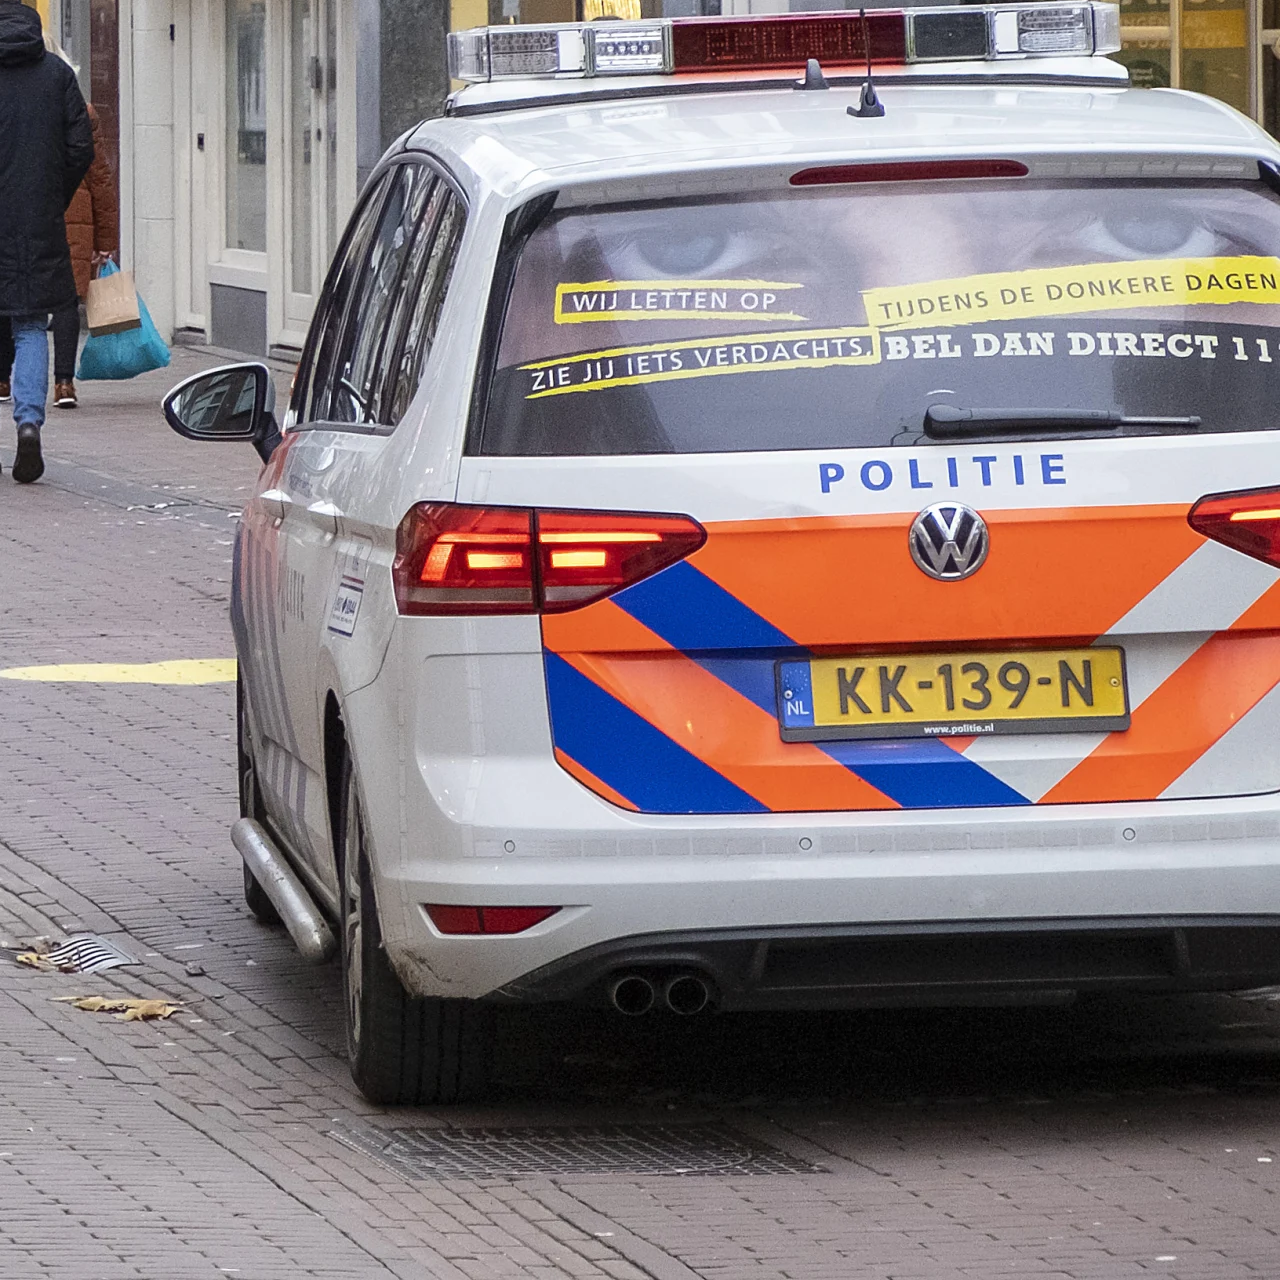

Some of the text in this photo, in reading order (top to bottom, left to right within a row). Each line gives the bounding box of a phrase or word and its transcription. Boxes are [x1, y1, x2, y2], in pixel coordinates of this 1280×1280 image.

[572, 291, 777, 312] WIJ LETTEN OP
[878, 272, 1278, 320] TIJDENS DE DONKERE DAGEN
[884, 331, 1280, 363] BEL DAN DIRECT 11
[532, 366, 571, 391] ZIE
[583, 360, 614, 382] JIJ
[627, 351, 684, 376] IETS
[818, 453, 1067, 494] POLITIE
[837, 660, 1095, 715] KK-139-N
[786, 700, 810, 716] NL
[924, 723, 995, 735] www.politie.nl
